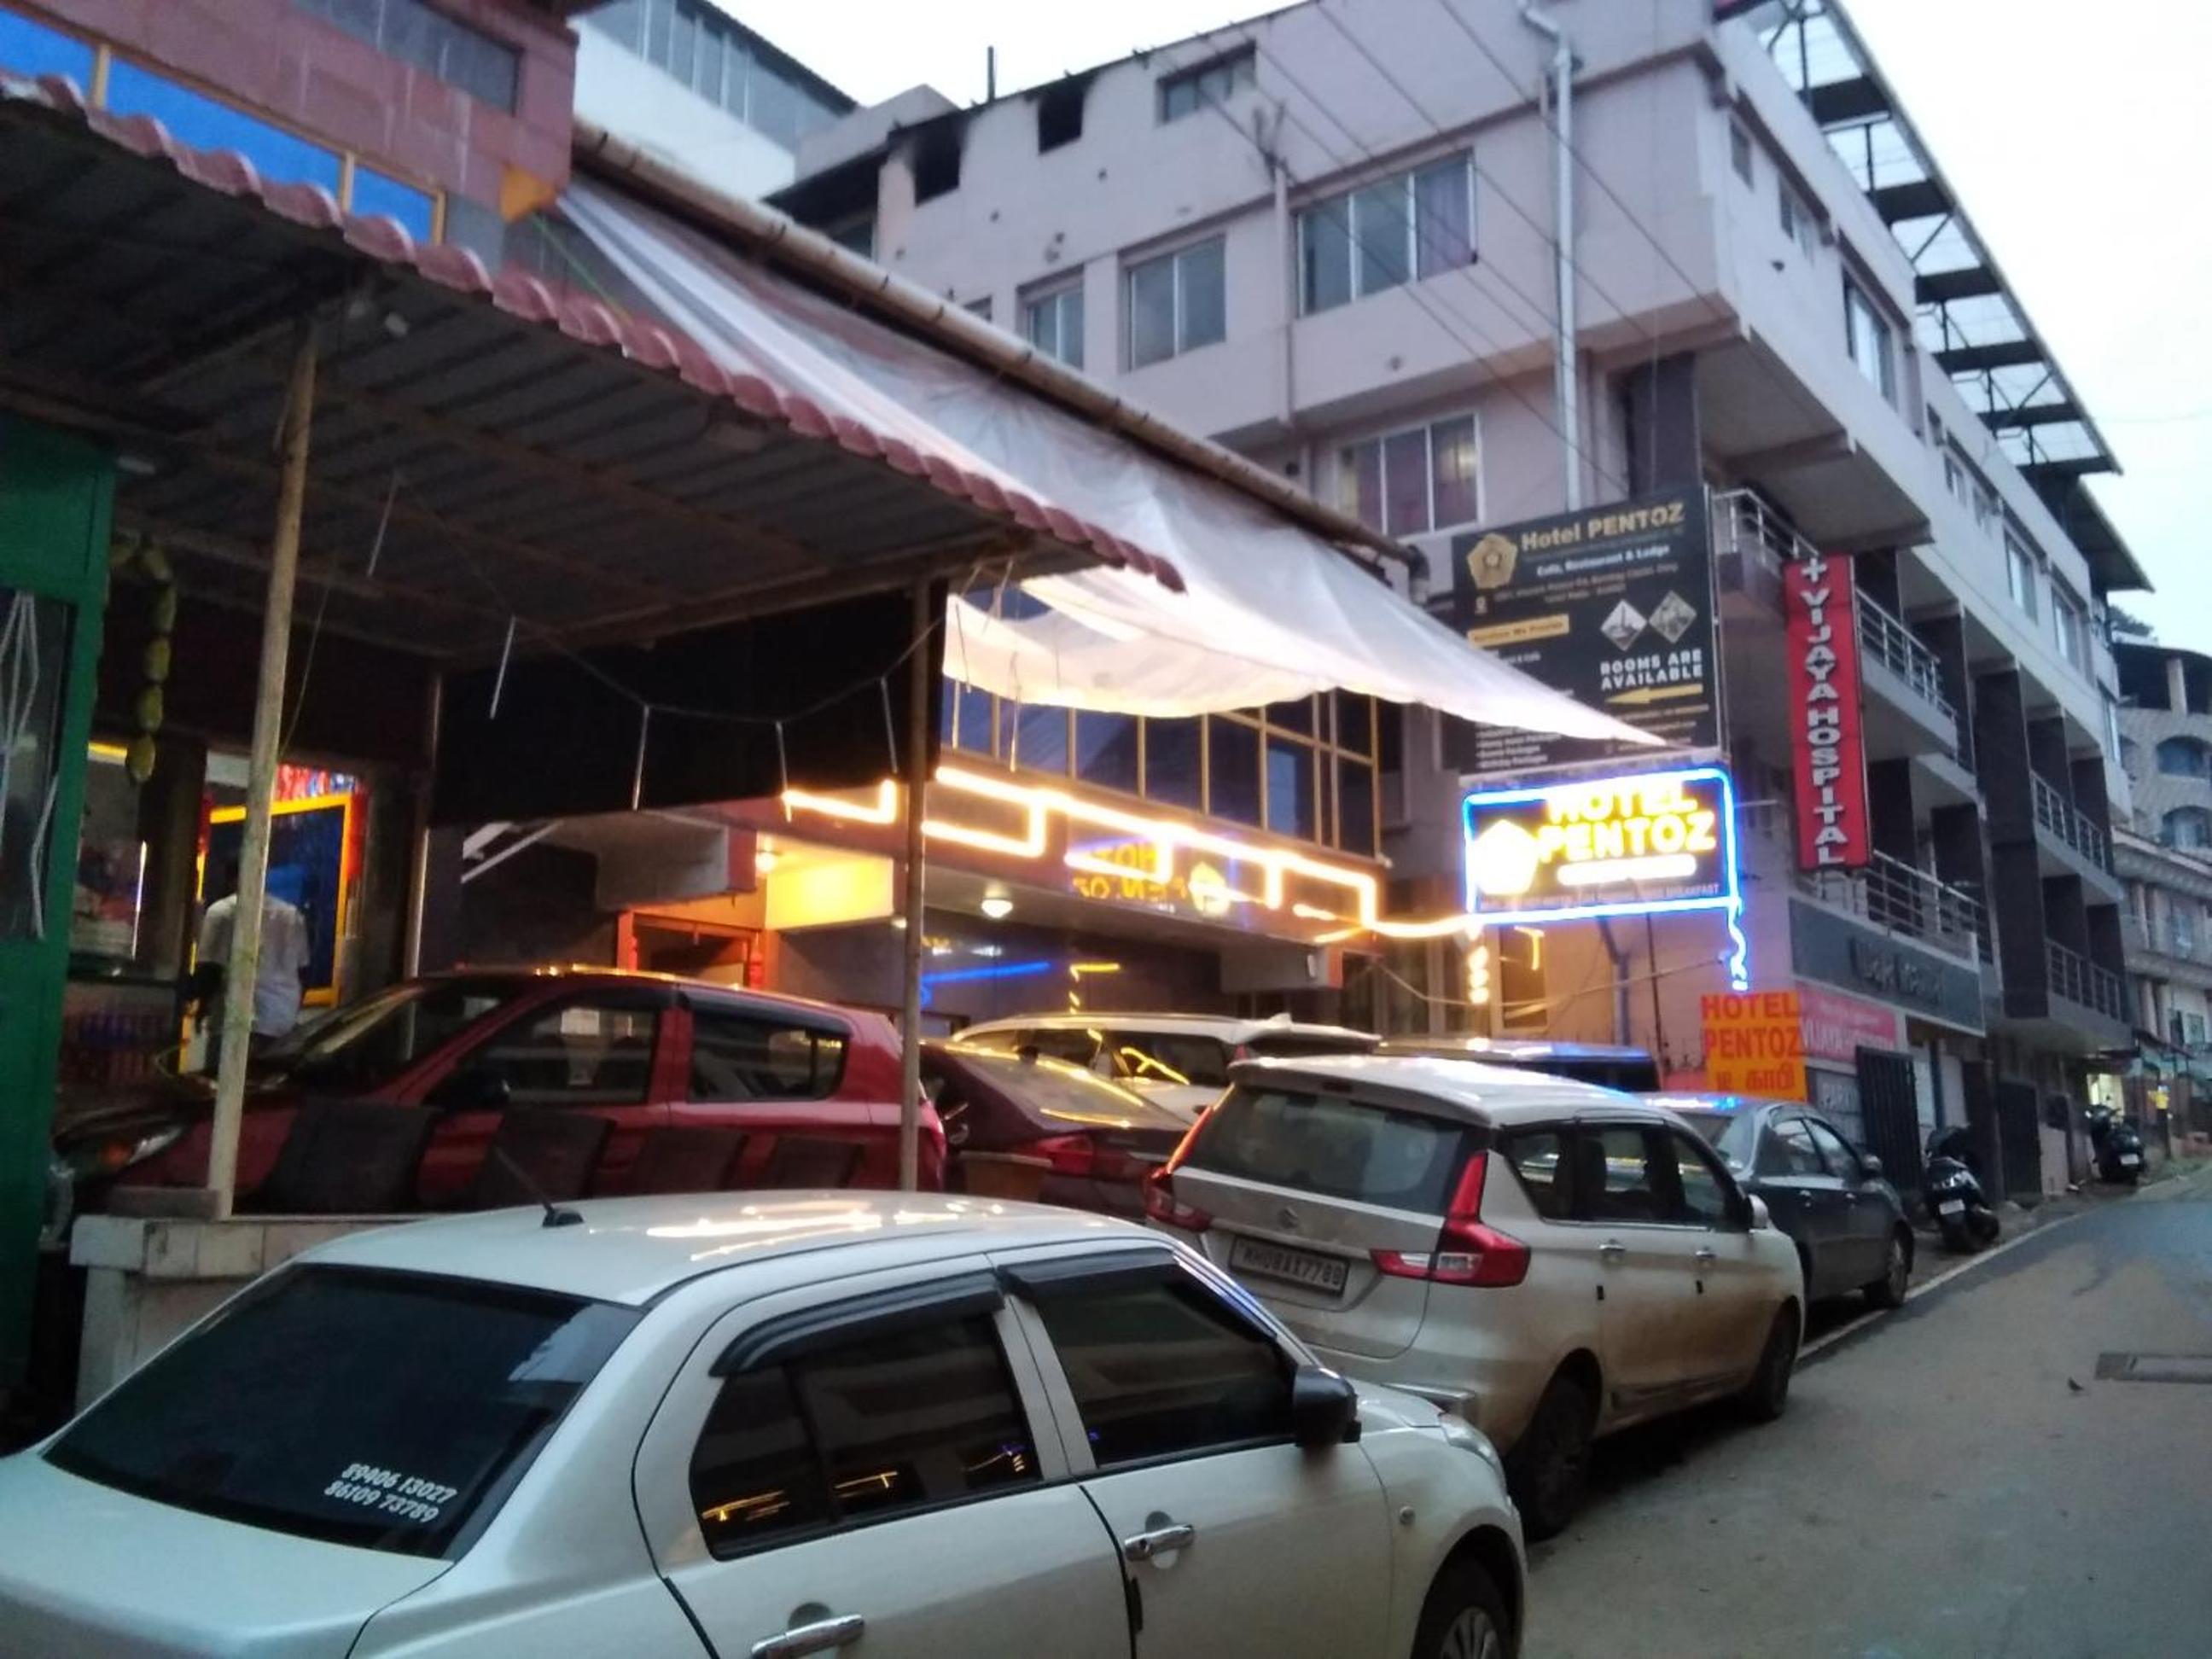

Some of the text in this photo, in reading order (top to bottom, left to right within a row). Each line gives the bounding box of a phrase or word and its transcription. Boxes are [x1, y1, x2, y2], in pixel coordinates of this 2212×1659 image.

[1521, 502, 1685, 552] Hotel PENTOZ
[1600, 649, 1703, 675] ROOMS ARE
[1800, 587, 1840, 702] VIJAYA
[1601, 664, 1703, 690] AVAILABLE
[1545, 777, 1698, 824] HOTEL
[1806, 706, 1848, 864] HOSPITAL
[1536, 809, 1717, 864] PENTOZ
[1701, 992, 1798, 1021] HOTEL
[1701, 1025, 1799, 1062] PENTOZ
[324, 1481, 439, 1522] 86109 73789
[341, 1463, 458, 1504] 89406 13027
